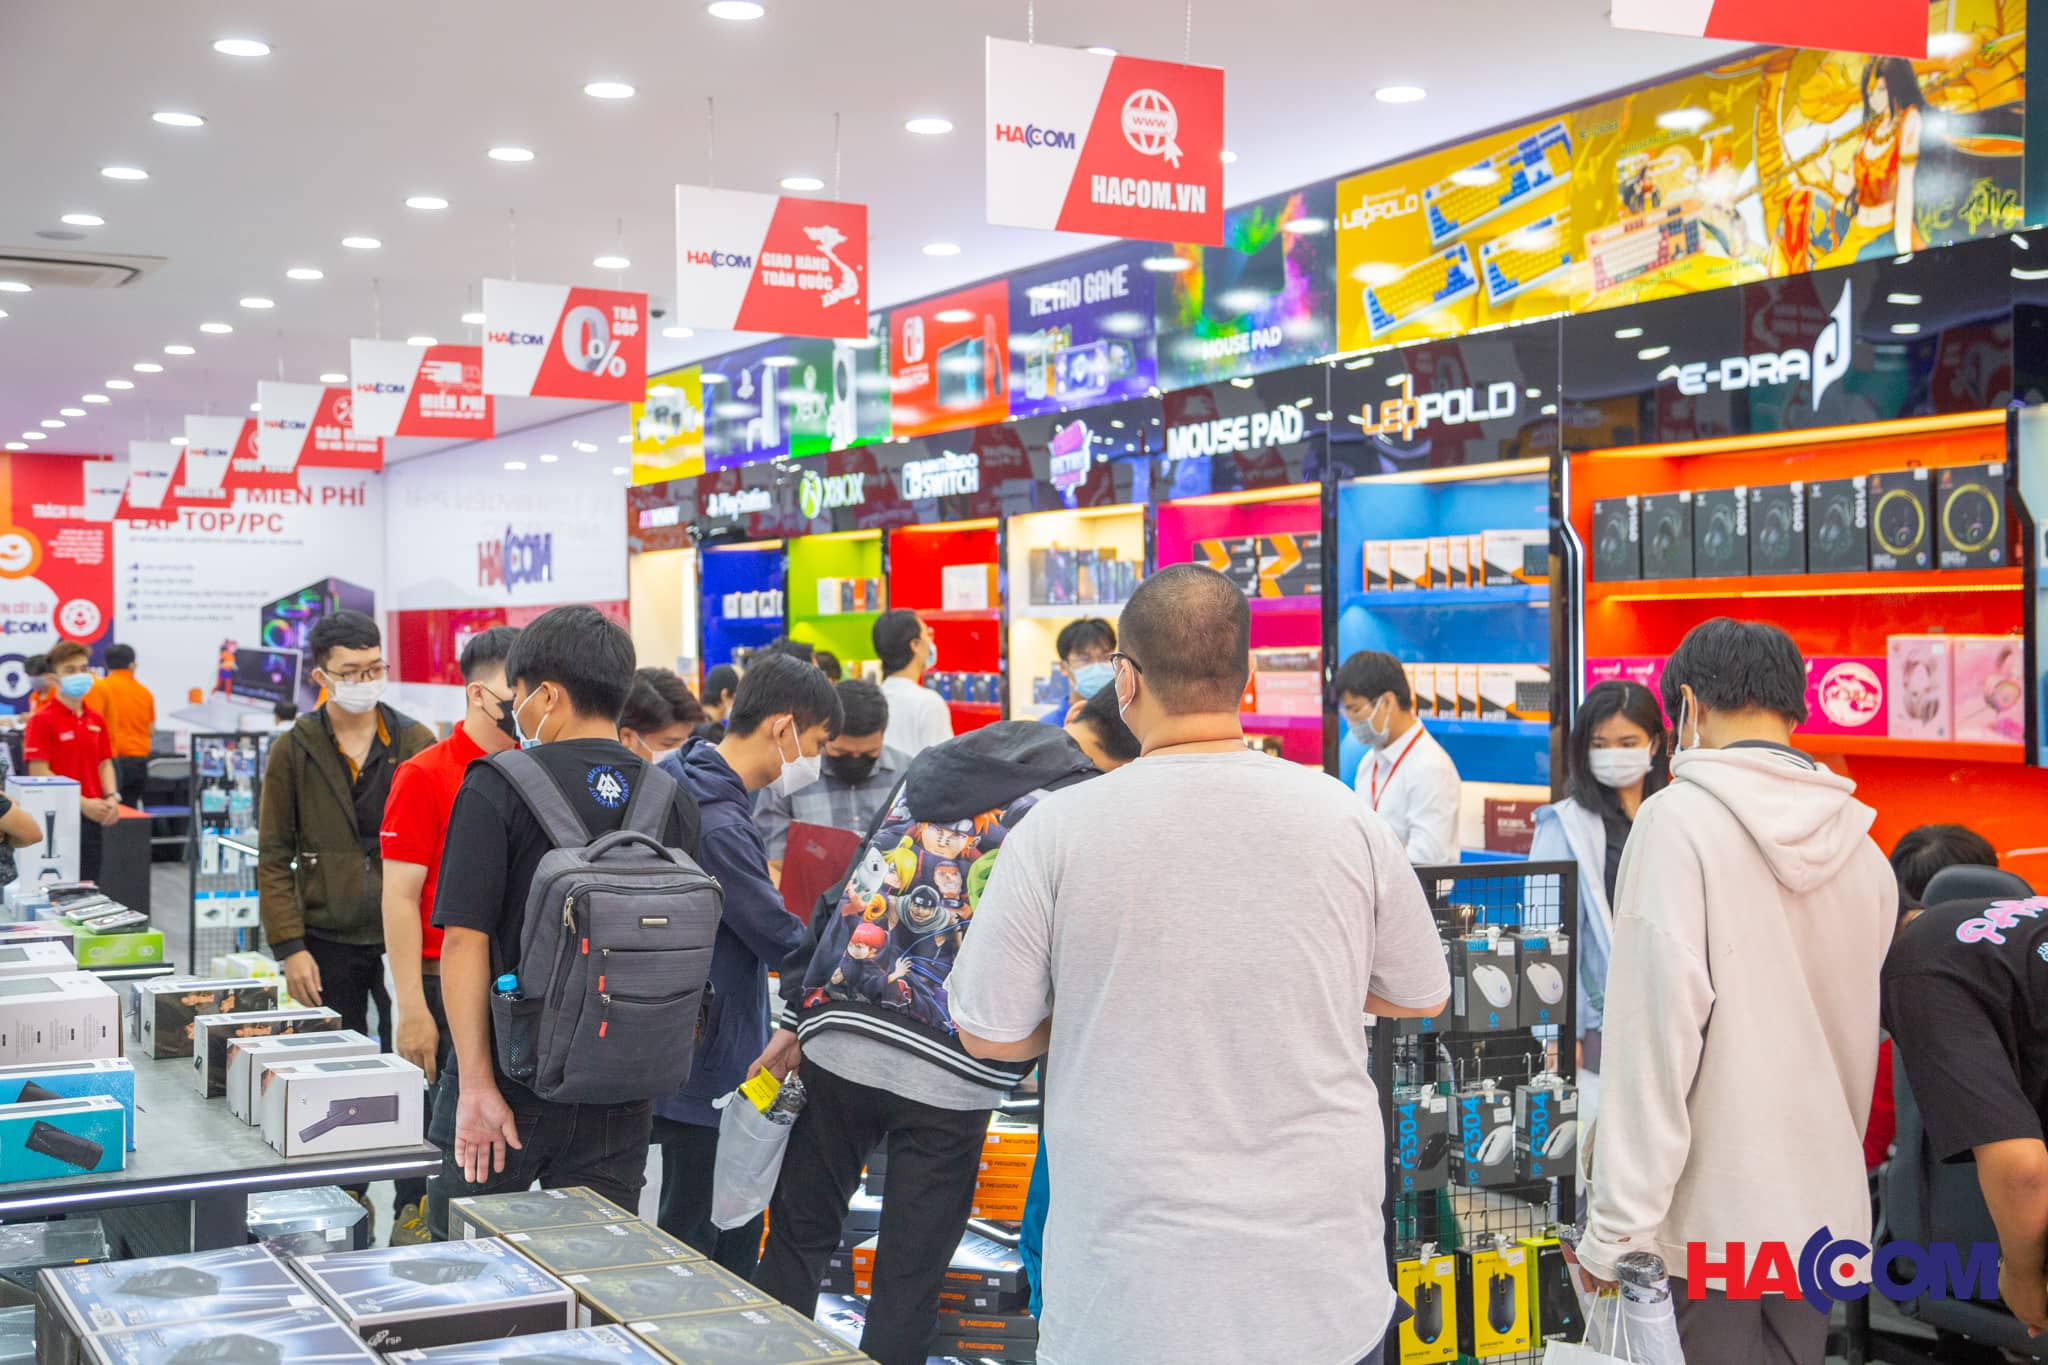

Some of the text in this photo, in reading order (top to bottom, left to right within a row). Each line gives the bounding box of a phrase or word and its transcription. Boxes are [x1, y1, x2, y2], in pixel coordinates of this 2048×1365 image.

[995, 123, 1075, 149] HACOM
[1091, 174, 1206, 213] HACOM.VN
[687, 250, 751, 268] HACOM
[761, 251, 830, 272] GIAO HÀNG
[761, 270, 796, 288] TOÀN
[1029, 264, 1129, 317] RETRO GAME
[488, 331, 545, 346] HACOM
[561, 306, 626, 378] 0%
[1201, 326, 1282, 360] MOUSE PAD
[357, 383, 405, 394] HACOM
[1362, 373, 1517, 442] LEOPOLD
[1167, 405, 1304, 461] MOUSE PAD
[322, 481, 366, 506] PHÍ
[823, 472, 865, 507] XBOX
[922, 468, 979, 499] SWITCH
[478, 523, 552, 595] HACOM
[1398, 1101, 1418, 1169] G304
[1462, 1094, 1483, 1164] G304
[1529, 1091, 1550, 1158] G304
